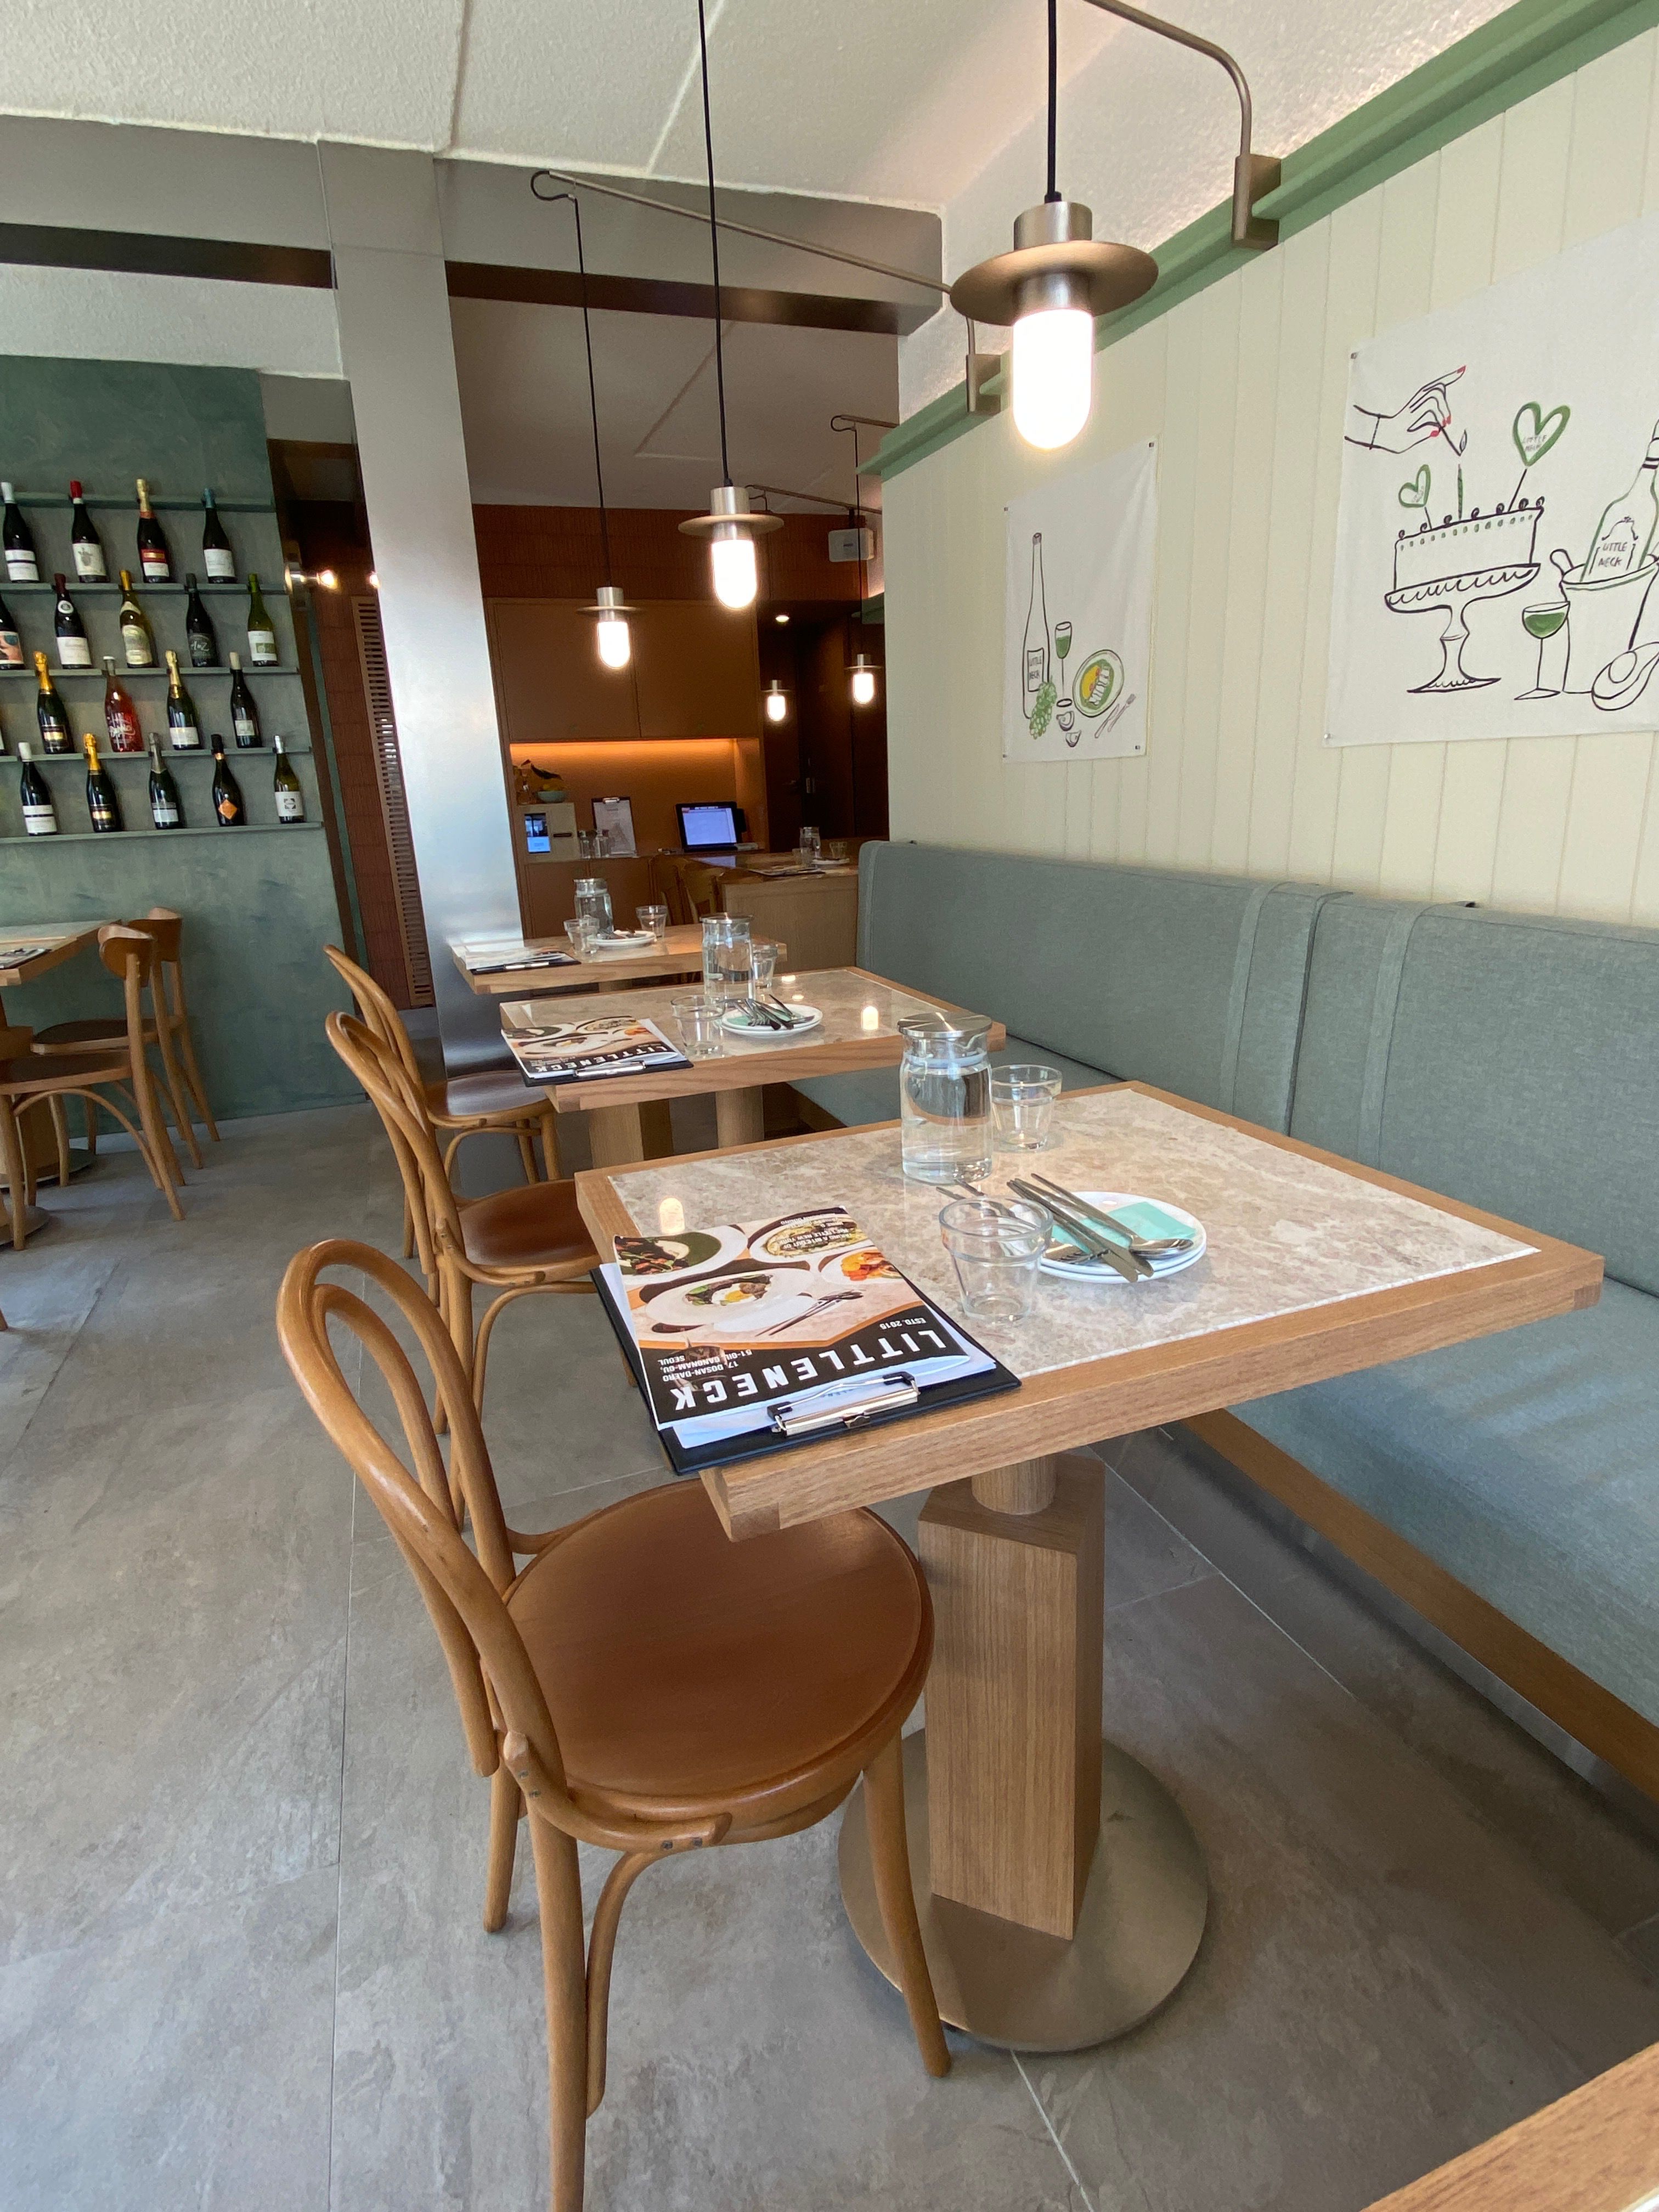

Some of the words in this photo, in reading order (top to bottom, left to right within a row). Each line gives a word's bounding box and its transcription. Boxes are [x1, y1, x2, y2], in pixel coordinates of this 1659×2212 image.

[657, 1355, 686, 1366] SEOUL
[662, 1364, 724, 1382] DOSAN-DAERO
[670, 1330, 946, 1410] LITTLENECK
